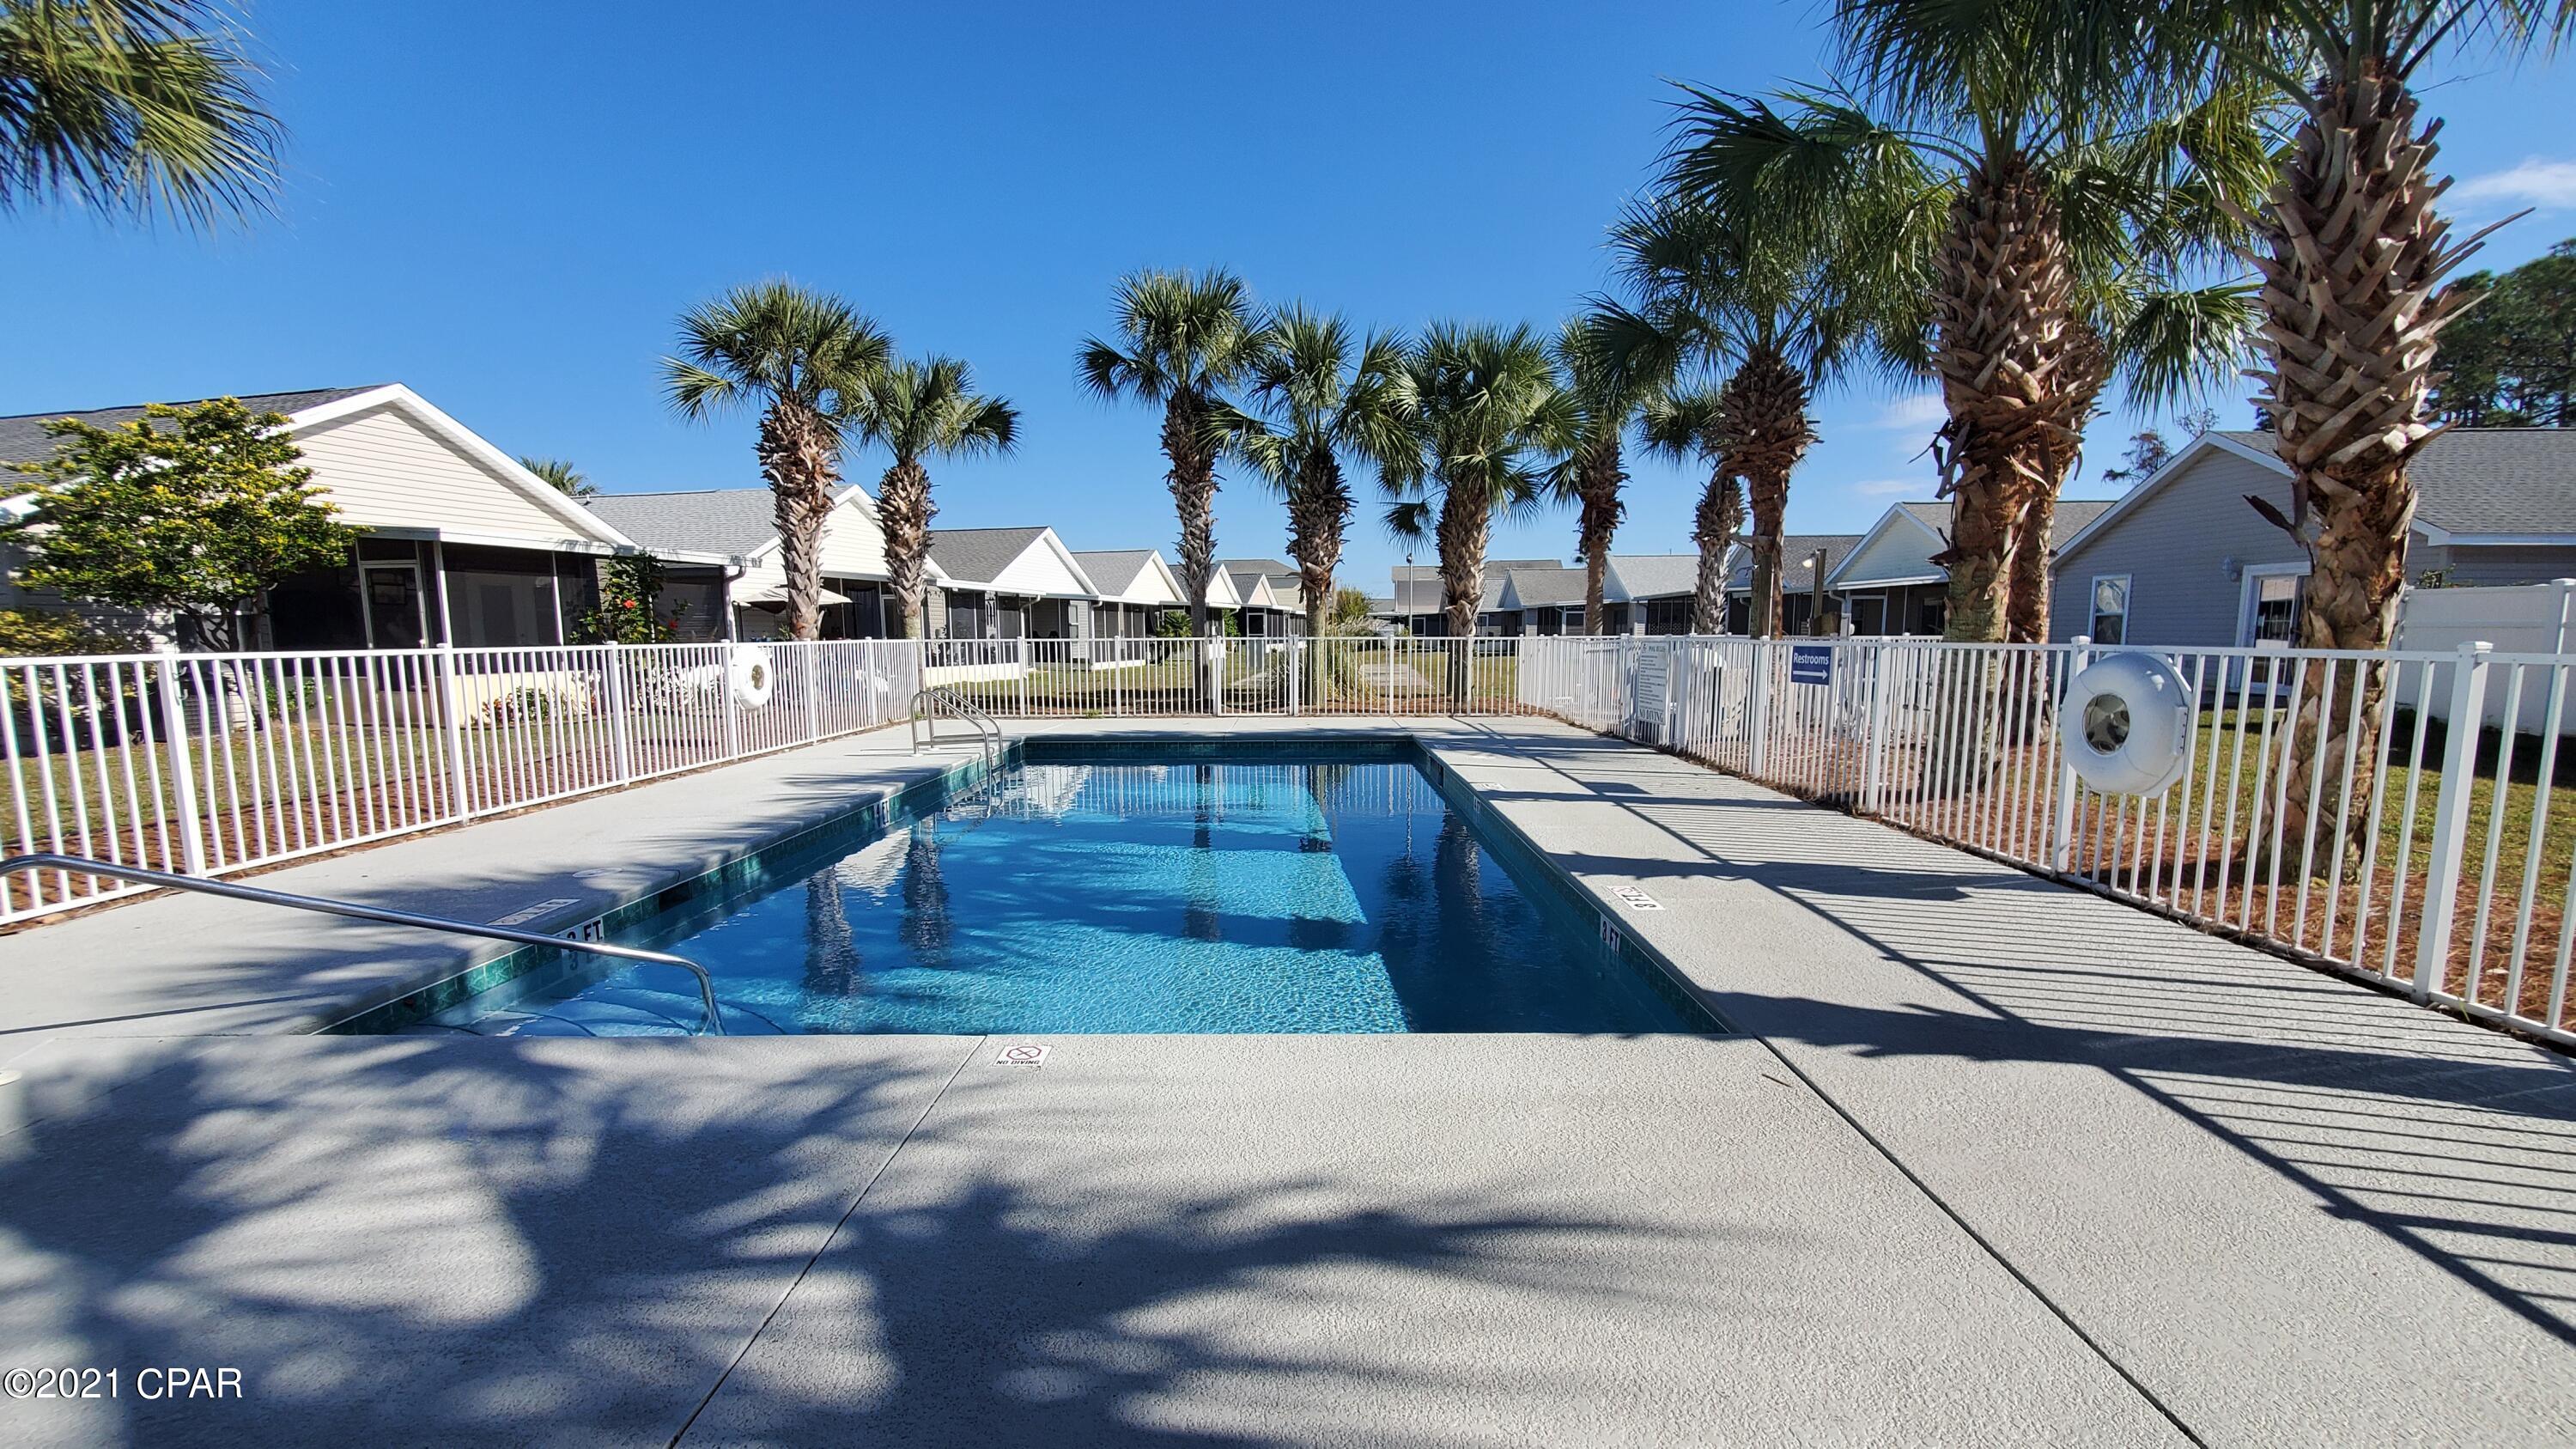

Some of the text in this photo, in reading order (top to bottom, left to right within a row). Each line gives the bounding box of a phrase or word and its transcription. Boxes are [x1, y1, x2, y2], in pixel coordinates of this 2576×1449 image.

[1793, 652, 1830, 666] Restrooms
[1639, 709, 1663, 723] NO DIVING
[1602, 920, 1607, 942] 3
